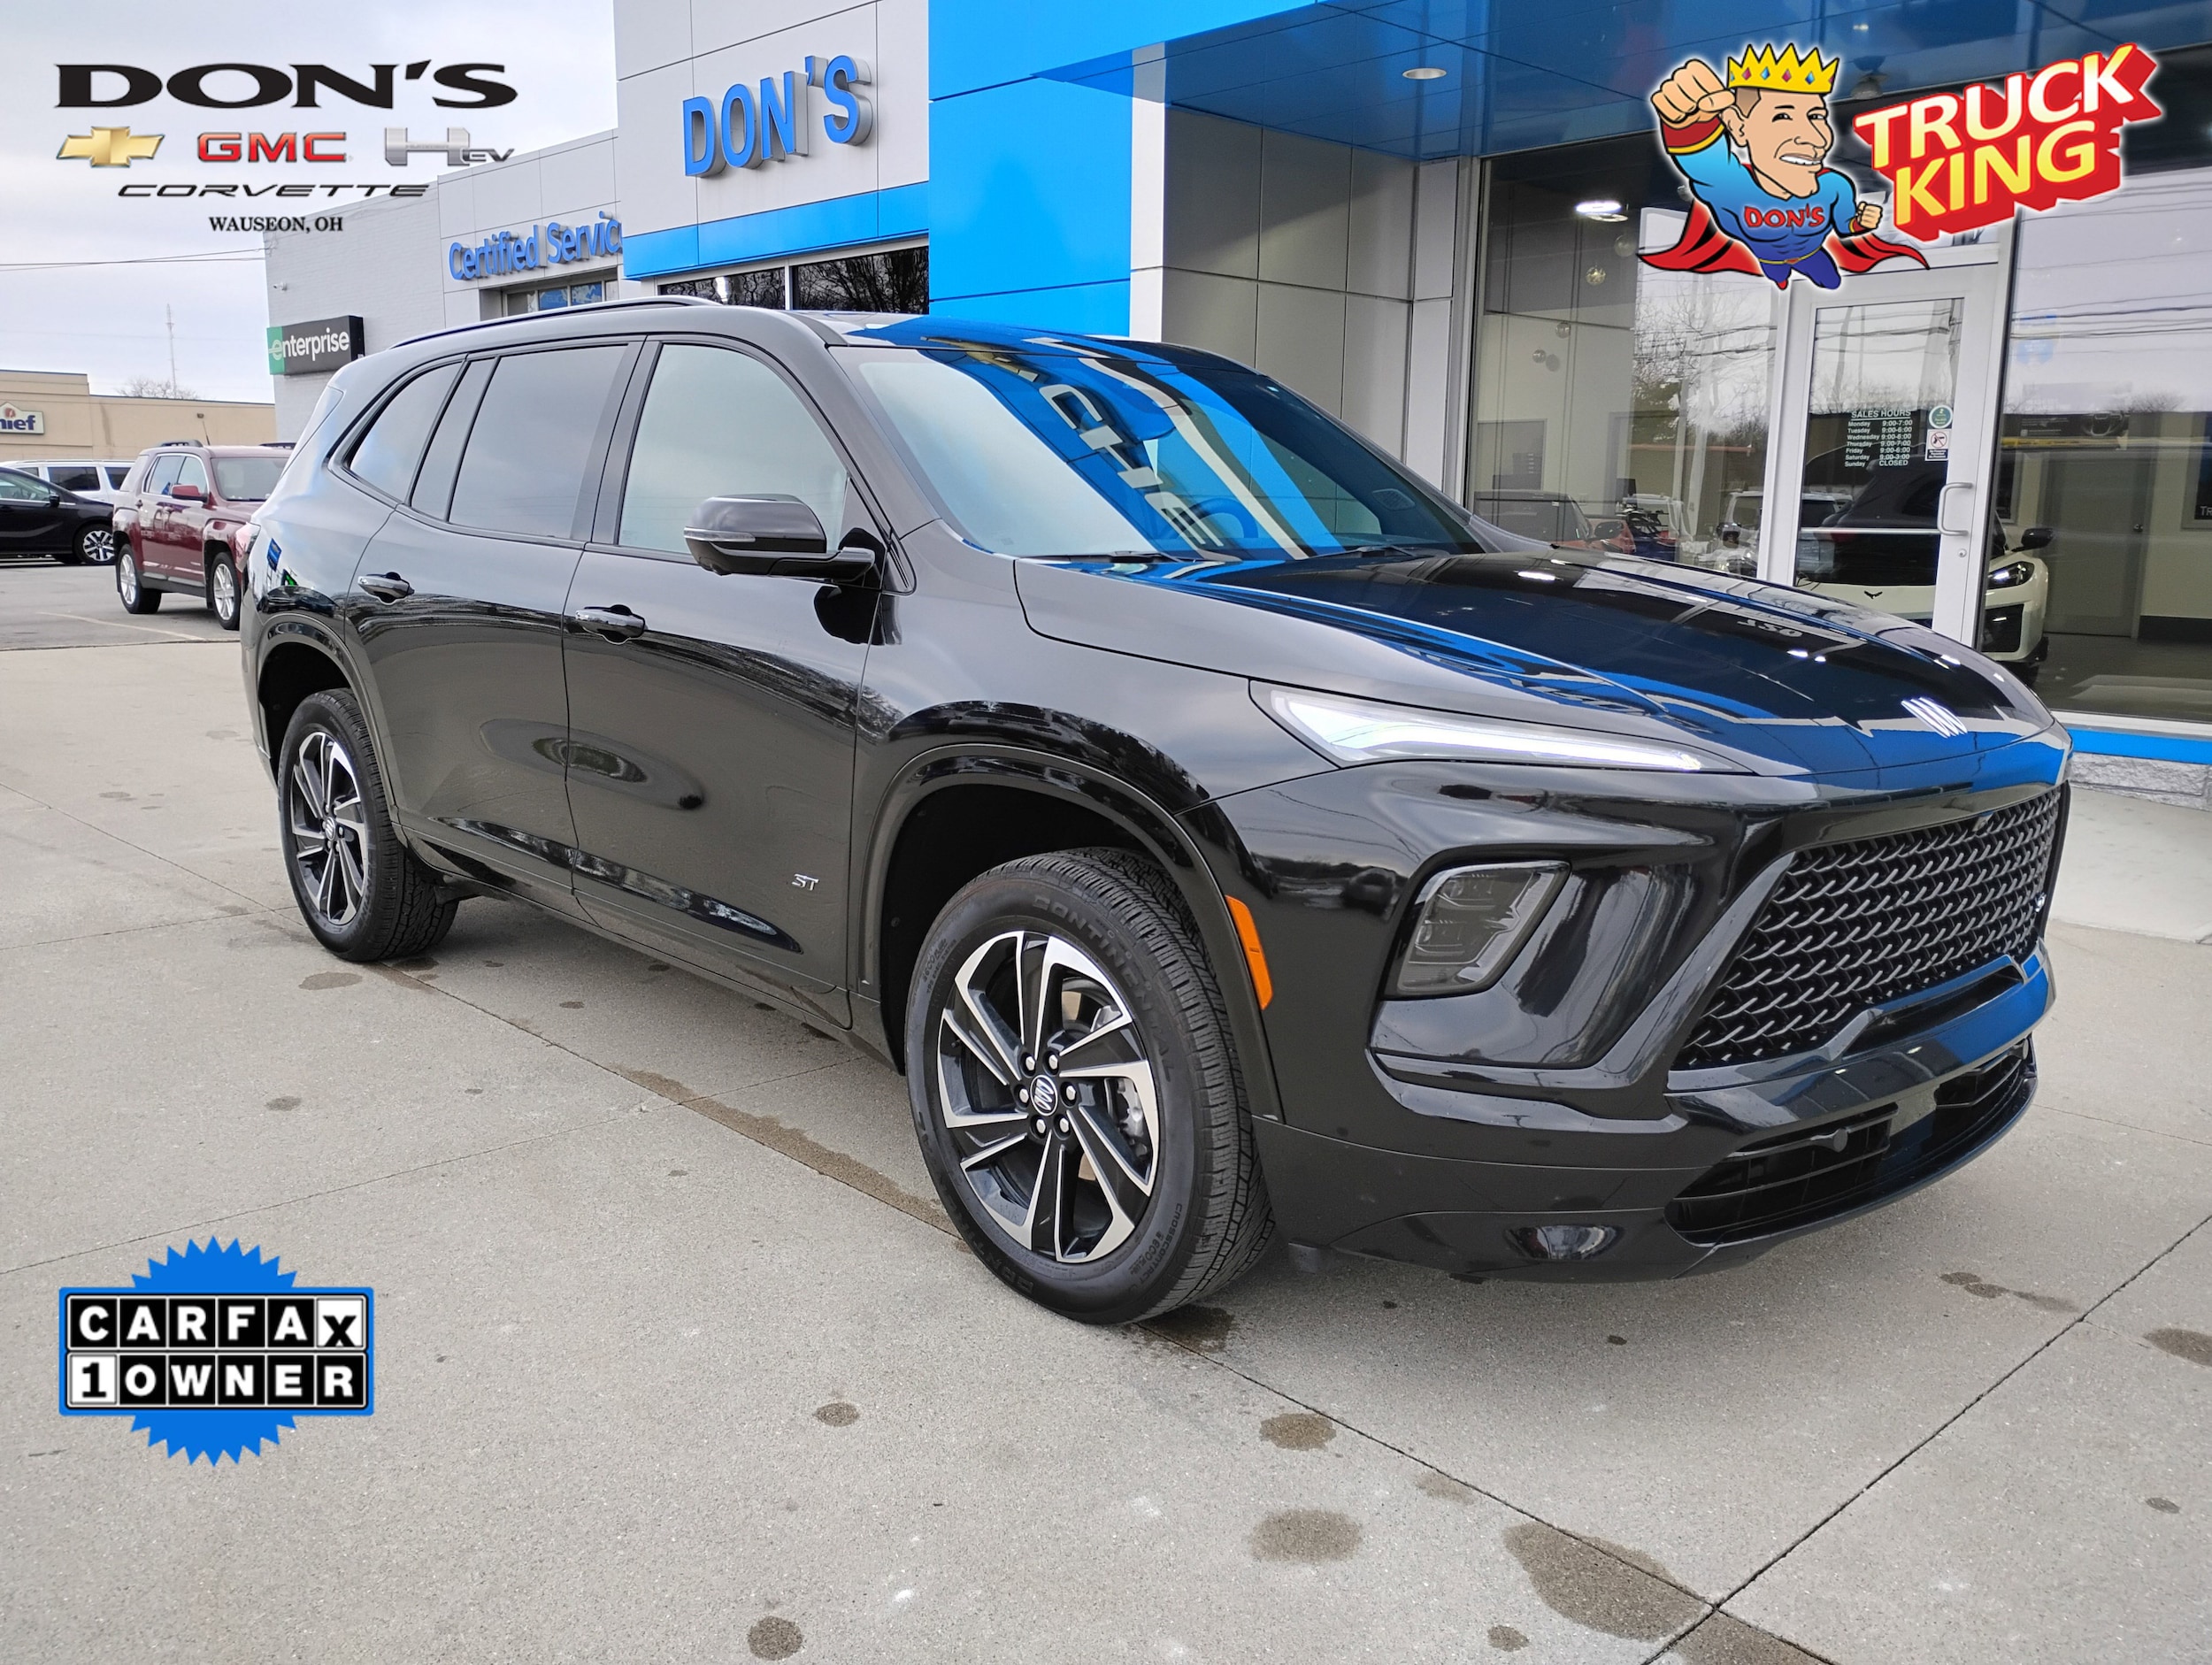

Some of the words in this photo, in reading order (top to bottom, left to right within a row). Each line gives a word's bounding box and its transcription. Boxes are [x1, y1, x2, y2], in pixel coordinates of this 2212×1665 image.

[682, 54, 872, 177] DON'S
[449, 224, 541, 280] Certified
[268, 326, 350, 362] enterprise
[791, 873, 819, 891] ST
